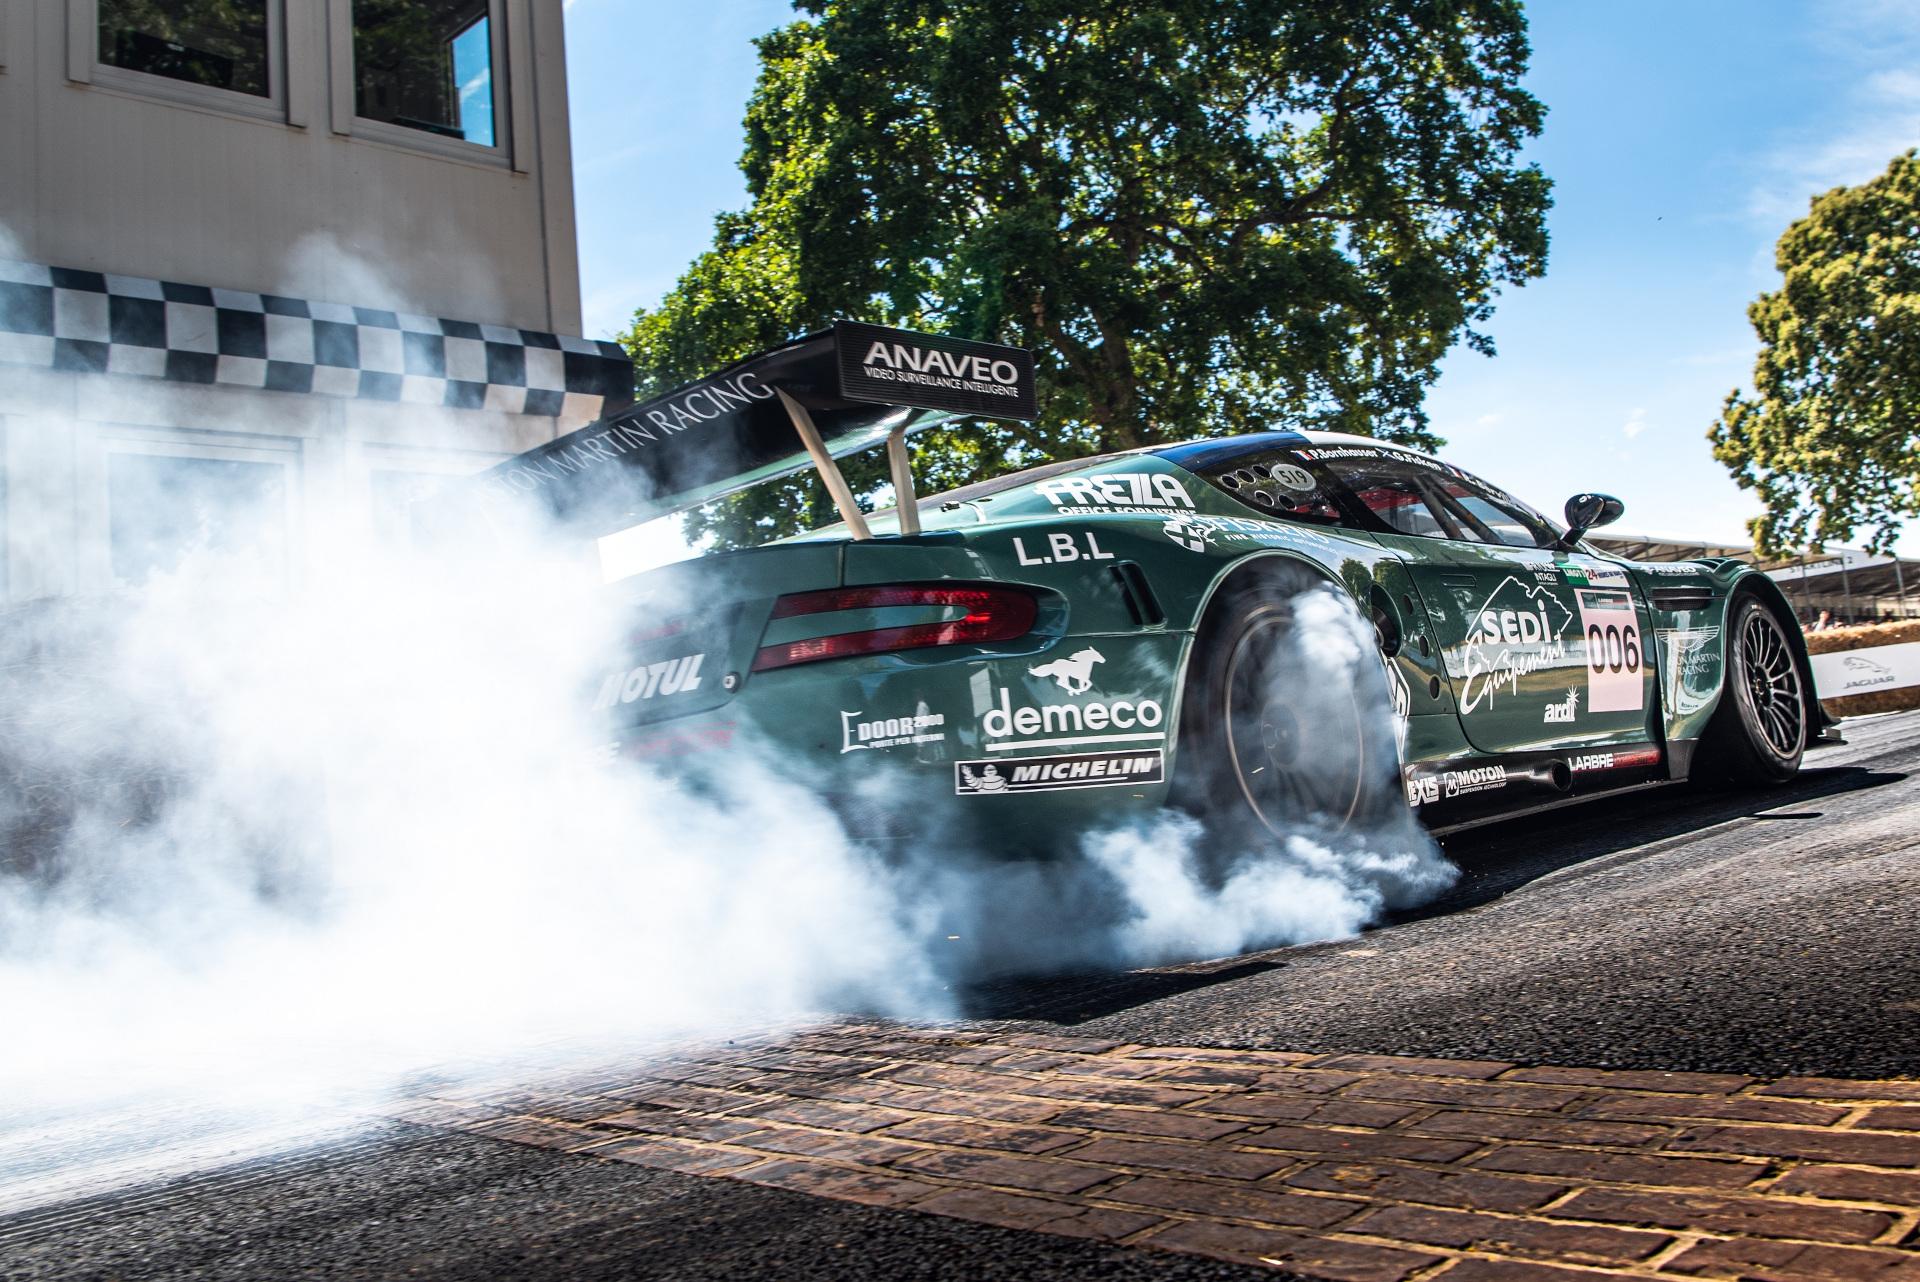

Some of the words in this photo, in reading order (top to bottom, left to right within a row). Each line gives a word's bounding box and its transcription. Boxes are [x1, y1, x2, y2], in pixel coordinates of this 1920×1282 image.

[863, 341, 1019, 385] ANAVEO
[863, 366, 895, 381] VIDEO
[897, 371, 962, 390] SURVEILLANCE
[963, 381, 1019, 398] INTELLIGENTE
[546, 418, 658, 477] MARTIN
[647, 372, 776, 436] RACING
[1278, 470, 1308, 484] 519
[1587, 623, 1639, 675] 006
[592, 653, 705, 711] MOTUL
[1843, 675, 1896, 690] JAGUAR
[983, 687, 1163, 738] demeco
[1011, 757, 1154, 782] MICHELIN
[1457, 765, 1506, 785] MOTON
[1567, 752, 1614, 772] LARBRE
